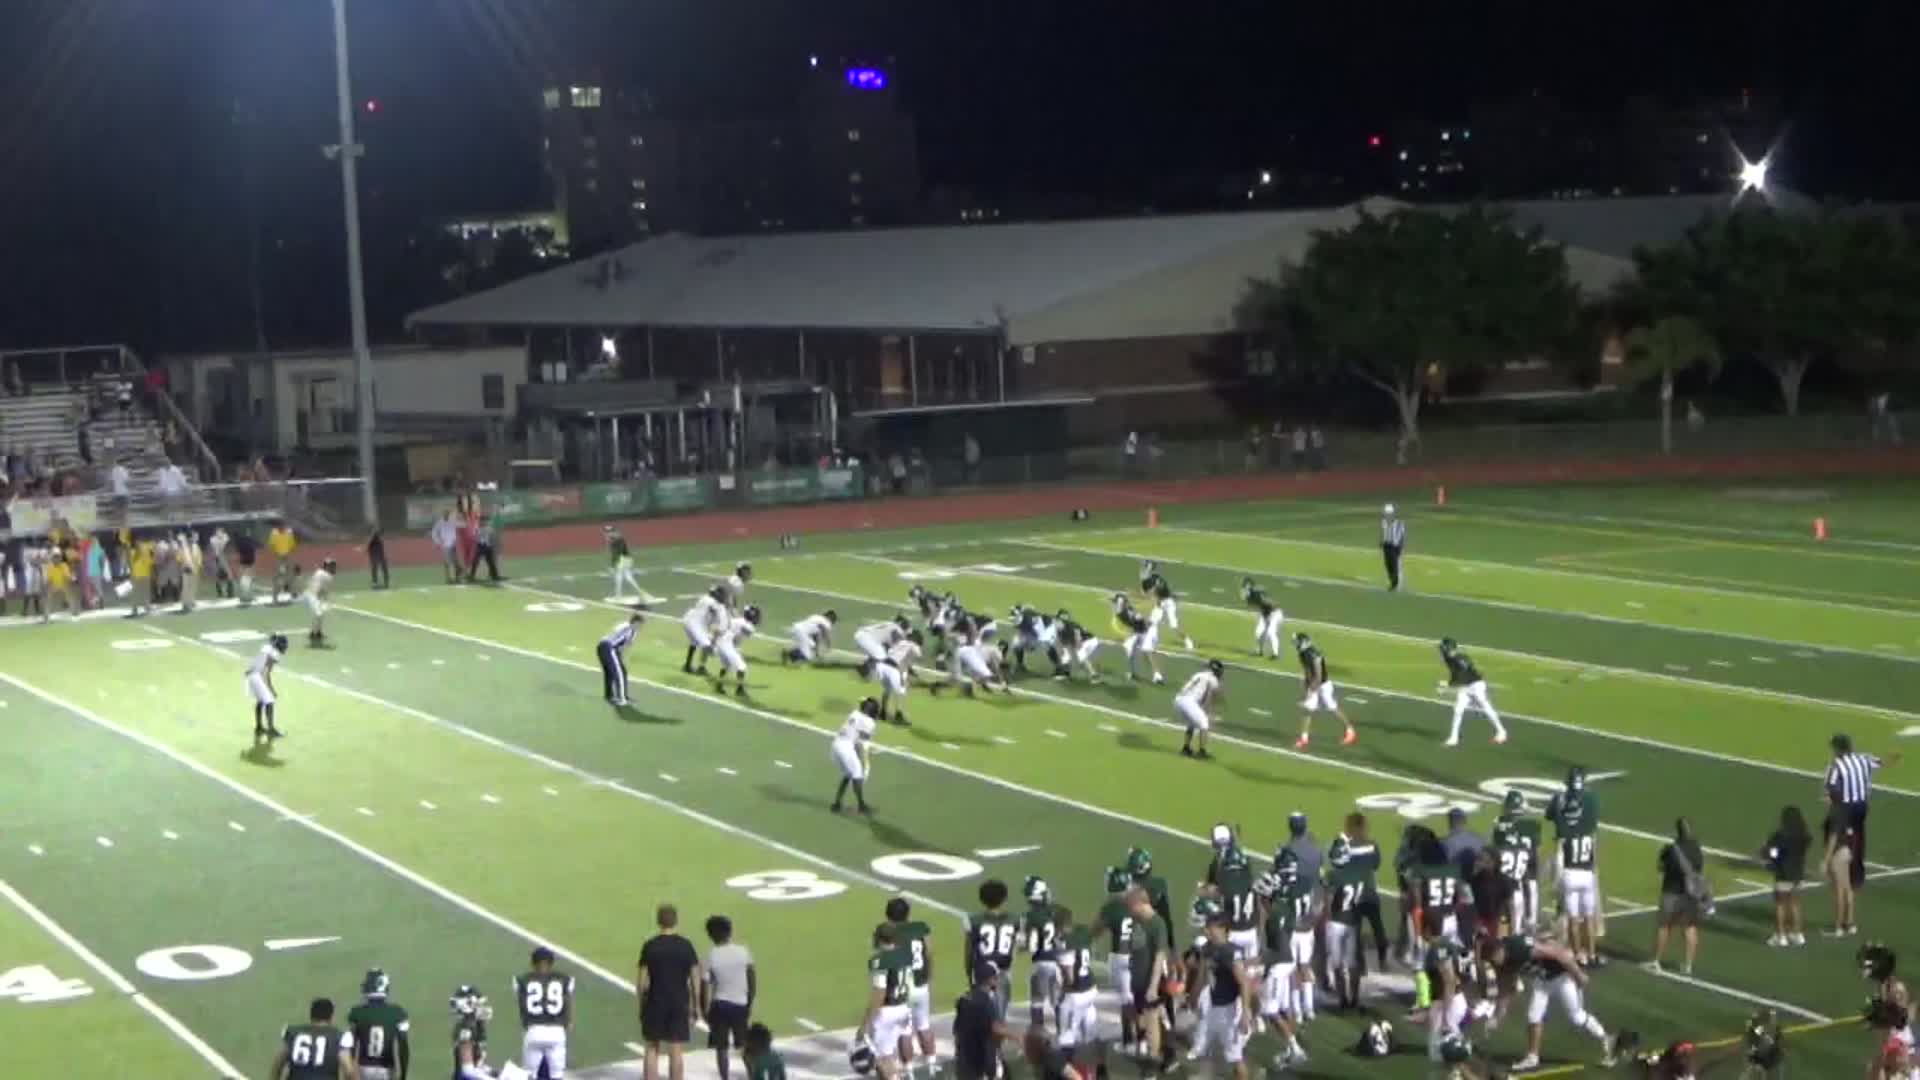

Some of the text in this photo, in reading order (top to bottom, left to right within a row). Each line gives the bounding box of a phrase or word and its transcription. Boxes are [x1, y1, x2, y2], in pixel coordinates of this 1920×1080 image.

[1232, 891, 1254, 922] 14
[1429, 878, 1456, 907] 55
[980, 924, 1014, 955] 36
[526, 980, 563, 1015] 29
[291, 1034, 326, 1066] 61
